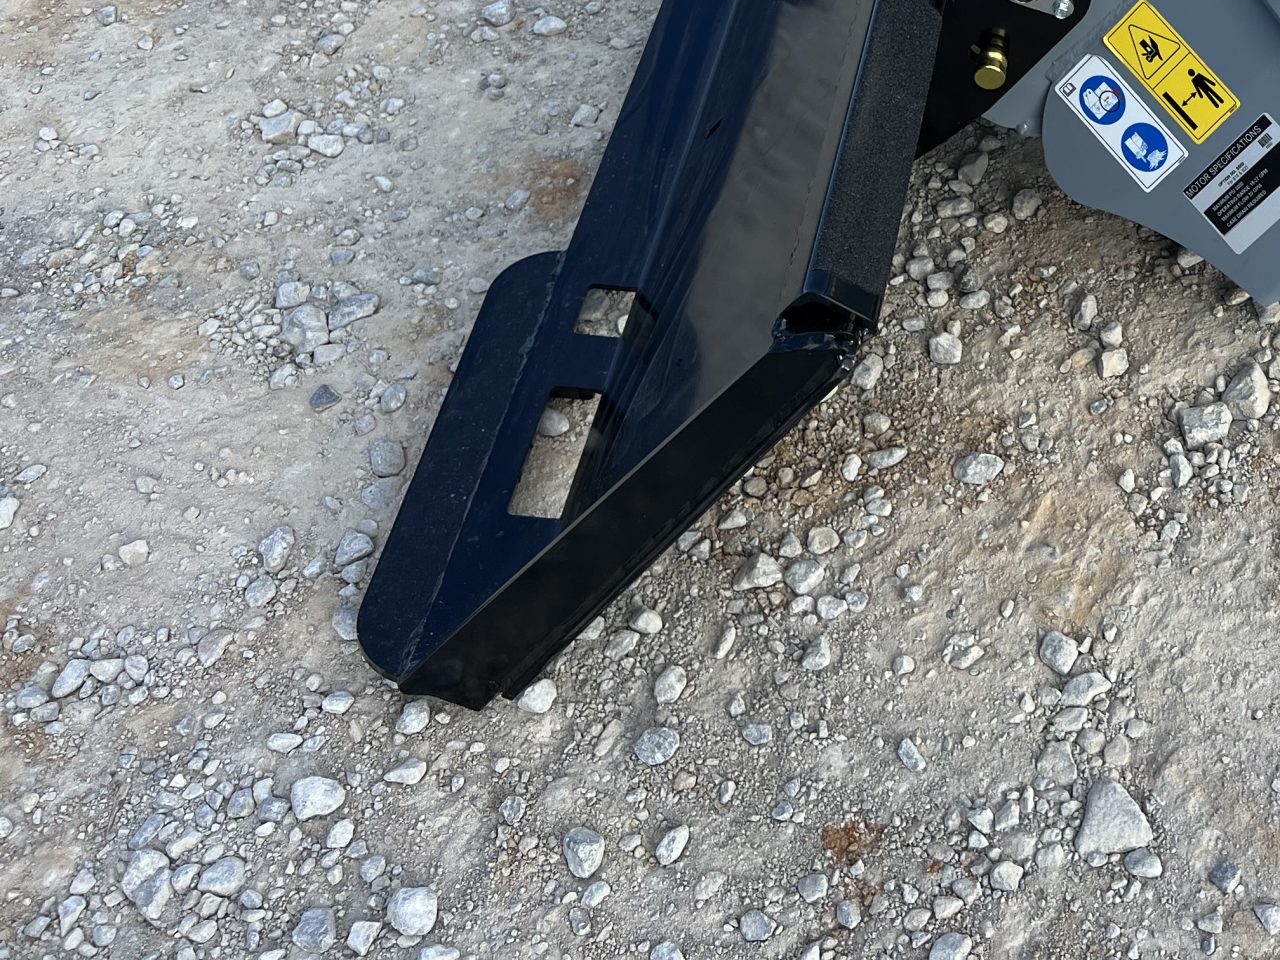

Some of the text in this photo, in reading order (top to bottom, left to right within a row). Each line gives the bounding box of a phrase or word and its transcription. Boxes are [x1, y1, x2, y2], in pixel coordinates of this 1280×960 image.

[1186, 125, 1261, 198] MOTOR SPECIFICATIONS
[1216, 196, 1238, 217] OPERATING
[1236, 184, 1250, 198] RANGE
[1258, 168, 1268, 178] GPM
[1226, 188, 1267, 227] CASE DRAIN REQUIRED
[1237, 194, 1249, 207] FLOW
